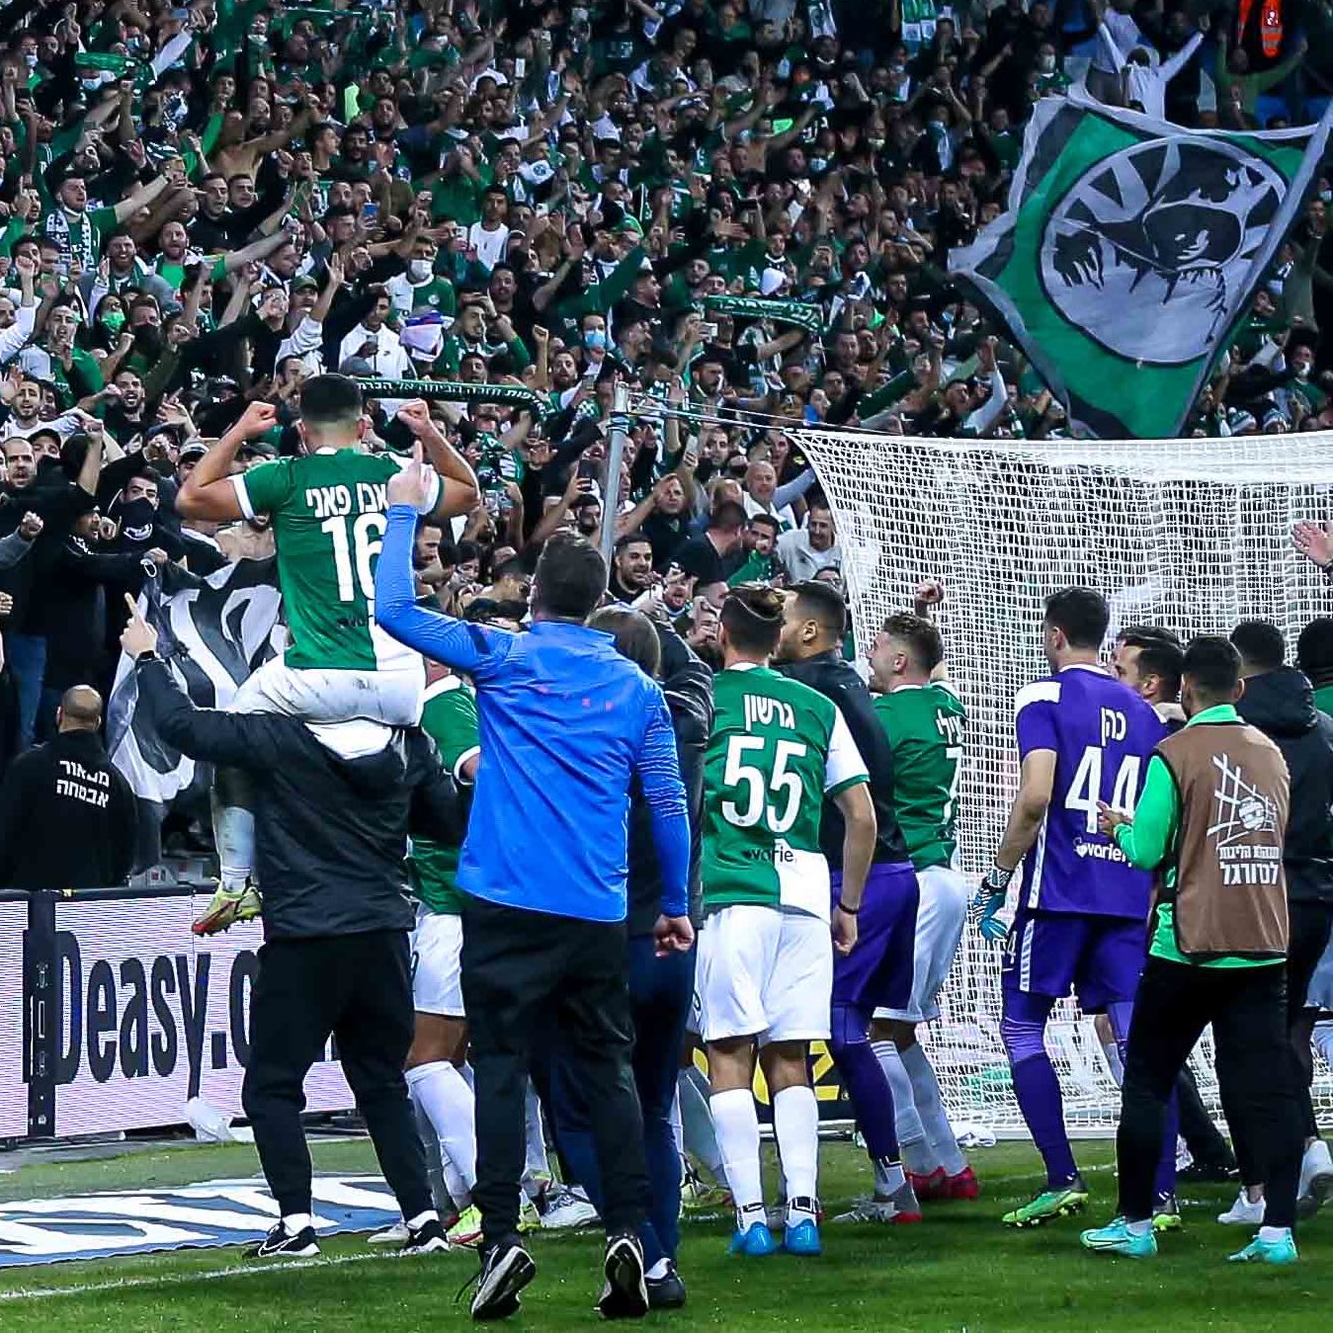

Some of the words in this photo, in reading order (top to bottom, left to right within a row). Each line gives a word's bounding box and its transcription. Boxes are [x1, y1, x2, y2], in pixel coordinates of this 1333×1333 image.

[305, 486, 350, 518] פאני
[322, 513, 388, 602] 16
[743, 693, 796, 731] גרשון
[1100, 705, 1127, 746] כהן
[56, 779, 110, 809] אבטחה
[721, 734, 808, 833] 55
[1065, 746, 1141, 834] 44
[1088, 843, 1133, 868] varie
